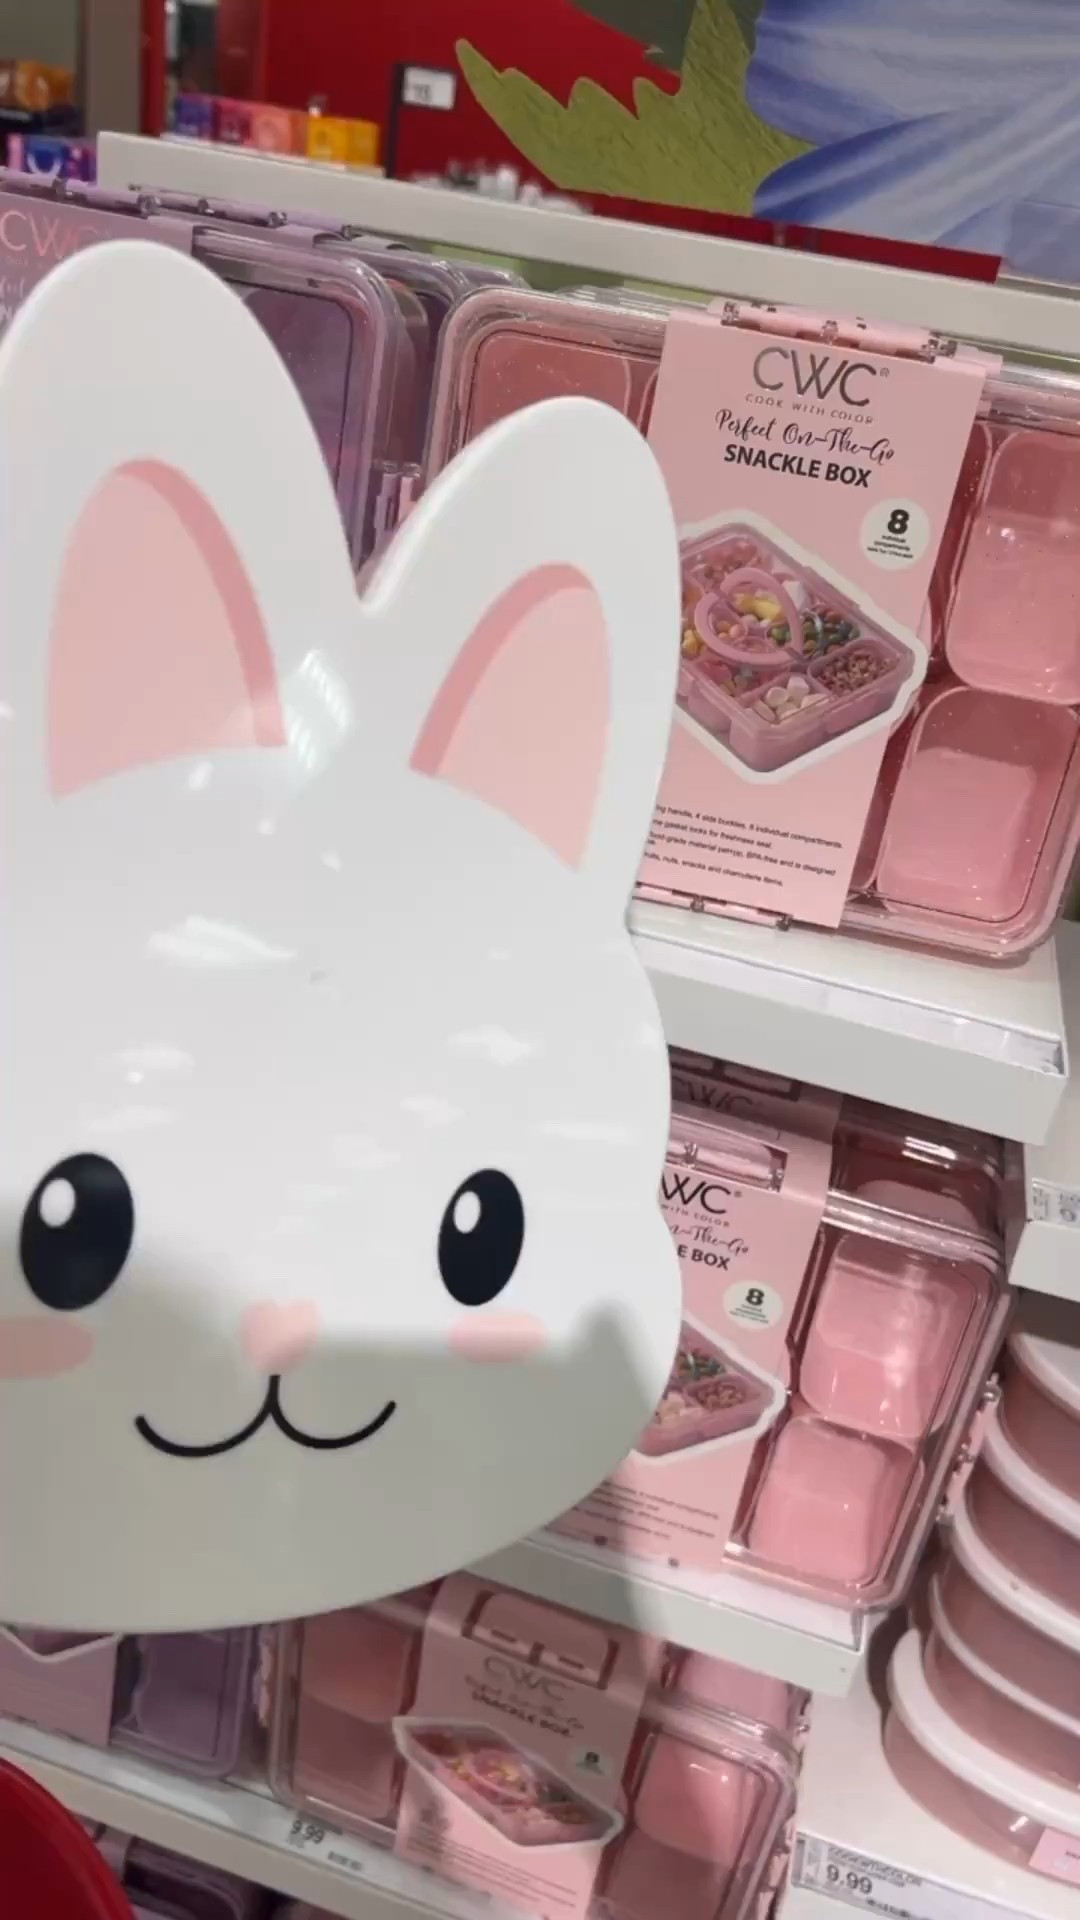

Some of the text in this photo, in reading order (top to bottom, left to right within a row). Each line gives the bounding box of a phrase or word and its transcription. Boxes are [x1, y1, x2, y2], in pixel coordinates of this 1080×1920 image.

[745, 393, 874, 424] COOK WITH COLOR
[715, 408, 896, 465] Perfect On-The-Go
[724, 444, 871, 488] SNACKLE BOX
[887, 508, 910, 535] 8
[690, 1247, 731, 1271] BOX
[745, 1287, 765, 1306] 8
[826, 1863, 873, 1896] 9.99
